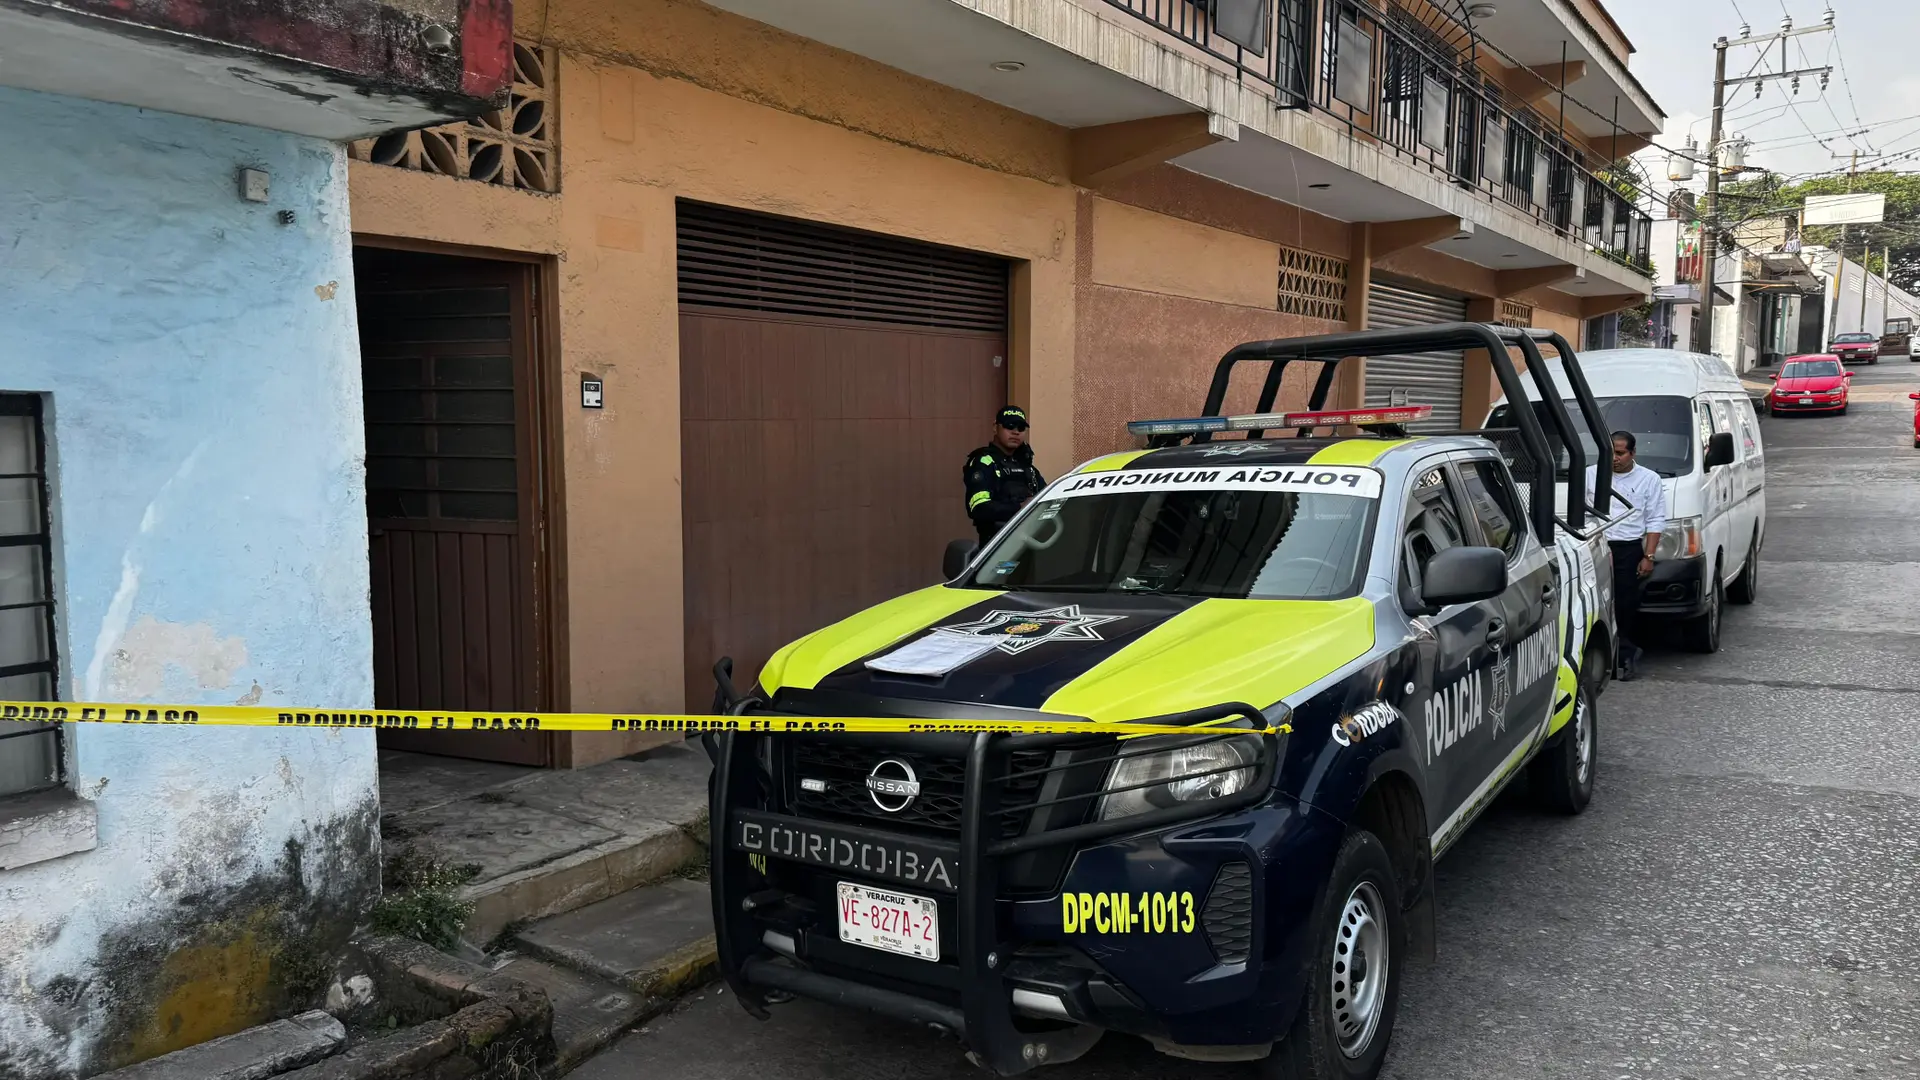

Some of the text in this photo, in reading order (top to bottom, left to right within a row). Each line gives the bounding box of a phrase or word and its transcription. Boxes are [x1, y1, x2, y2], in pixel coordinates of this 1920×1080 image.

[1424, 624, 1560, 766] POLICÍA MUNICIPAL
[866, 778, 918, 794] NISSAN
[742, 822, 954, 888] CORDOBA
[841, 897, 933, 941] VE-827A-2
[866, 890, 906, 905] VERACRUZ
[1062, 891, 1195, 934] DPCM-1013
